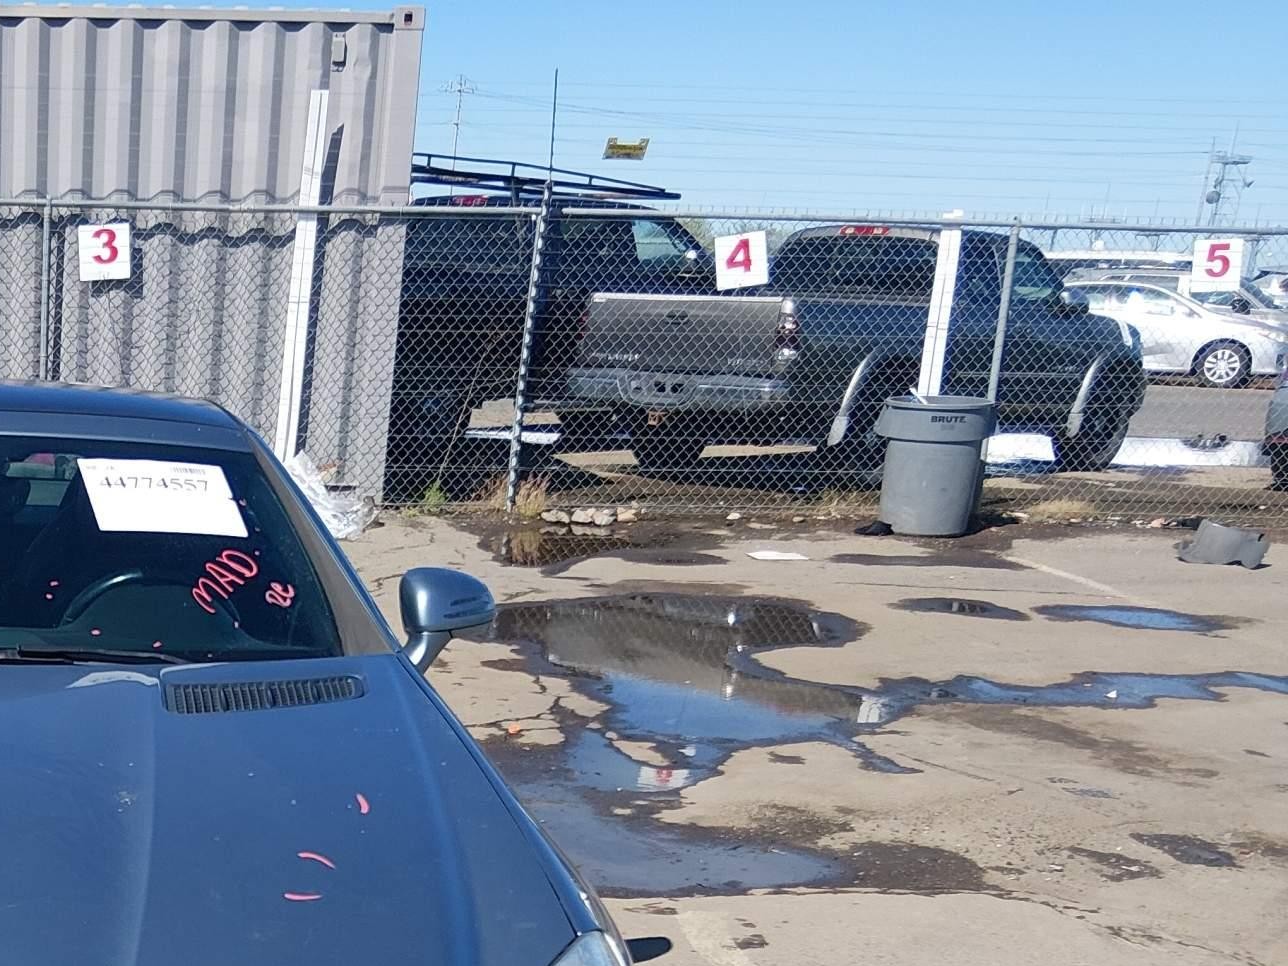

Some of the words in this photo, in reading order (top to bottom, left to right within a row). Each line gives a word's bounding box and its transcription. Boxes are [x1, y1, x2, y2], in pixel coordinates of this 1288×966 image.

[92, 228, 119, 265] 3
[726, 238, 752, 273] 4
[1205, 243, 1231, 278] 5
[930, 415, 968, 424] BRUTE
[99, 475, 209, 493] 44774557
